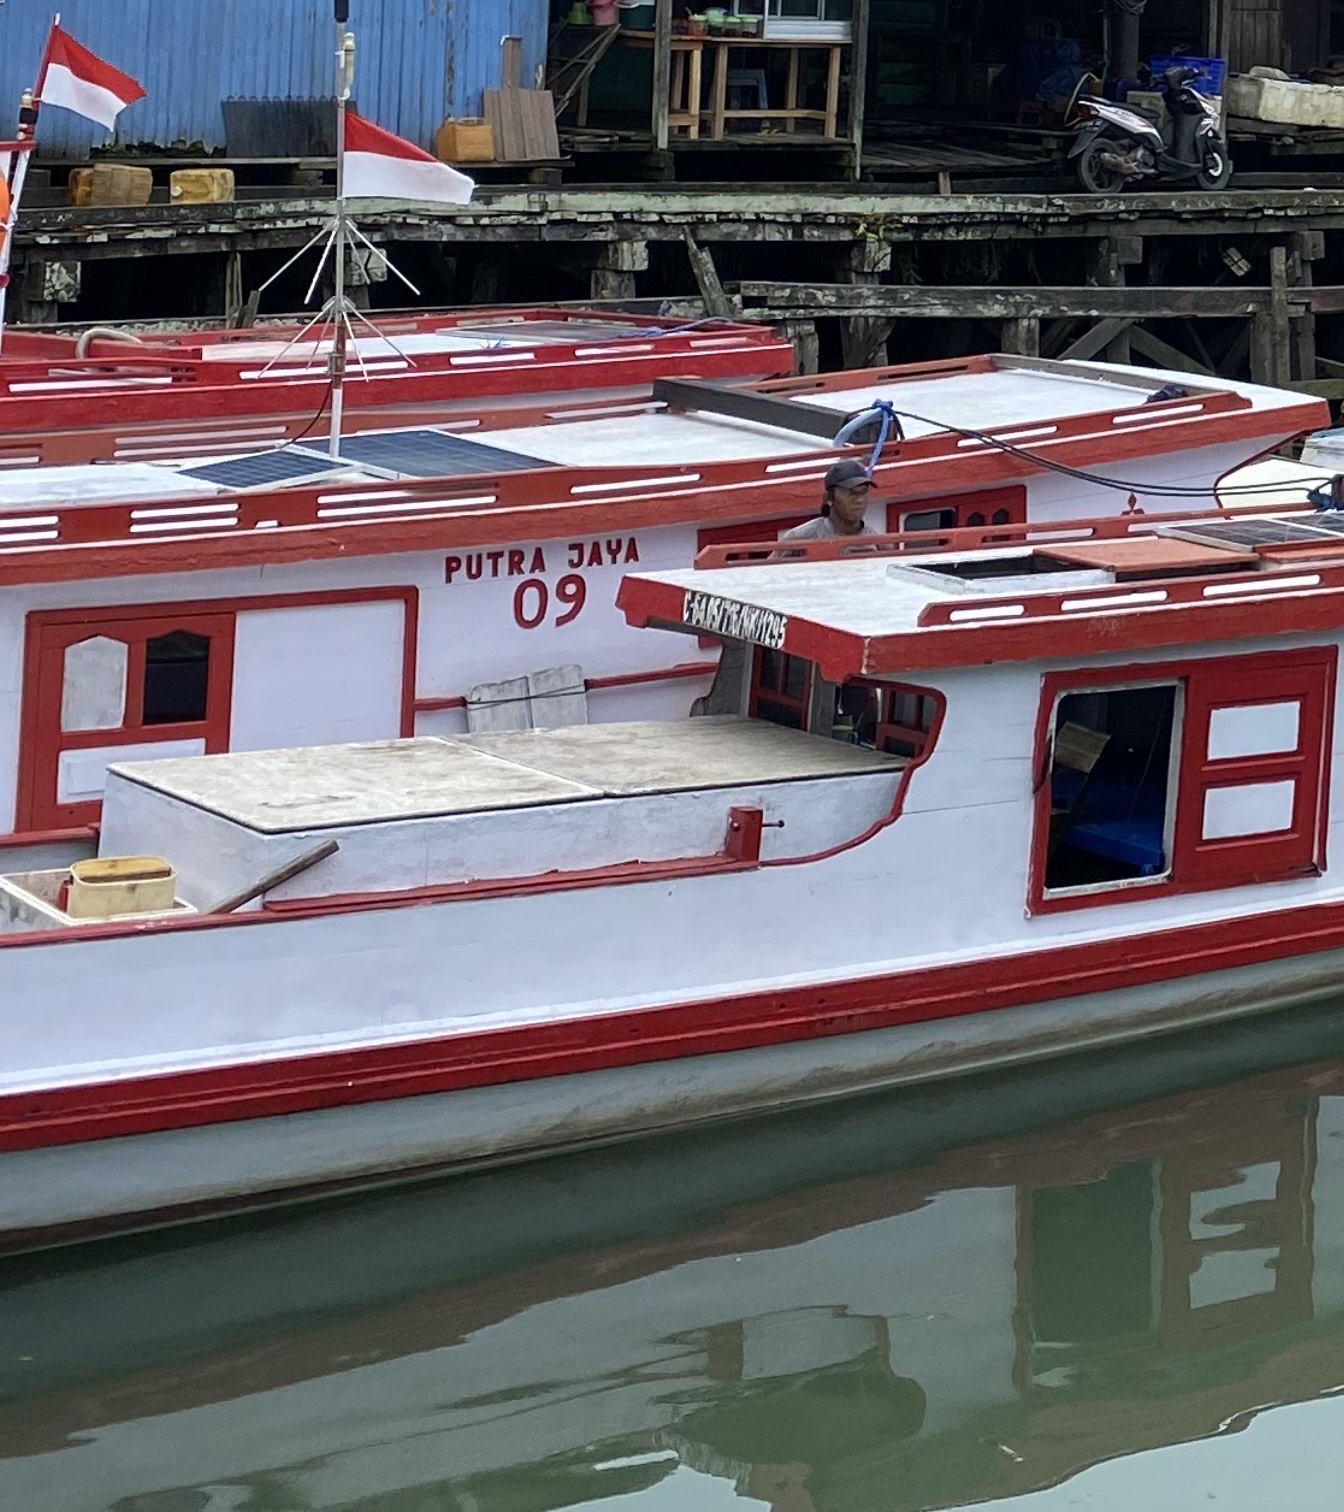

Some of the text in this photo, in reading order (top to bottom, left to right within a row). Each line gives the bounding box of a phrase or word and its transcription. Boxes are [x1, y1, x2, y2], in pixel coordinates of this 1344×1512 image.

[445, 537, 640, 584] PUTRA JAYA
[514, 573, 586, 630] 09
